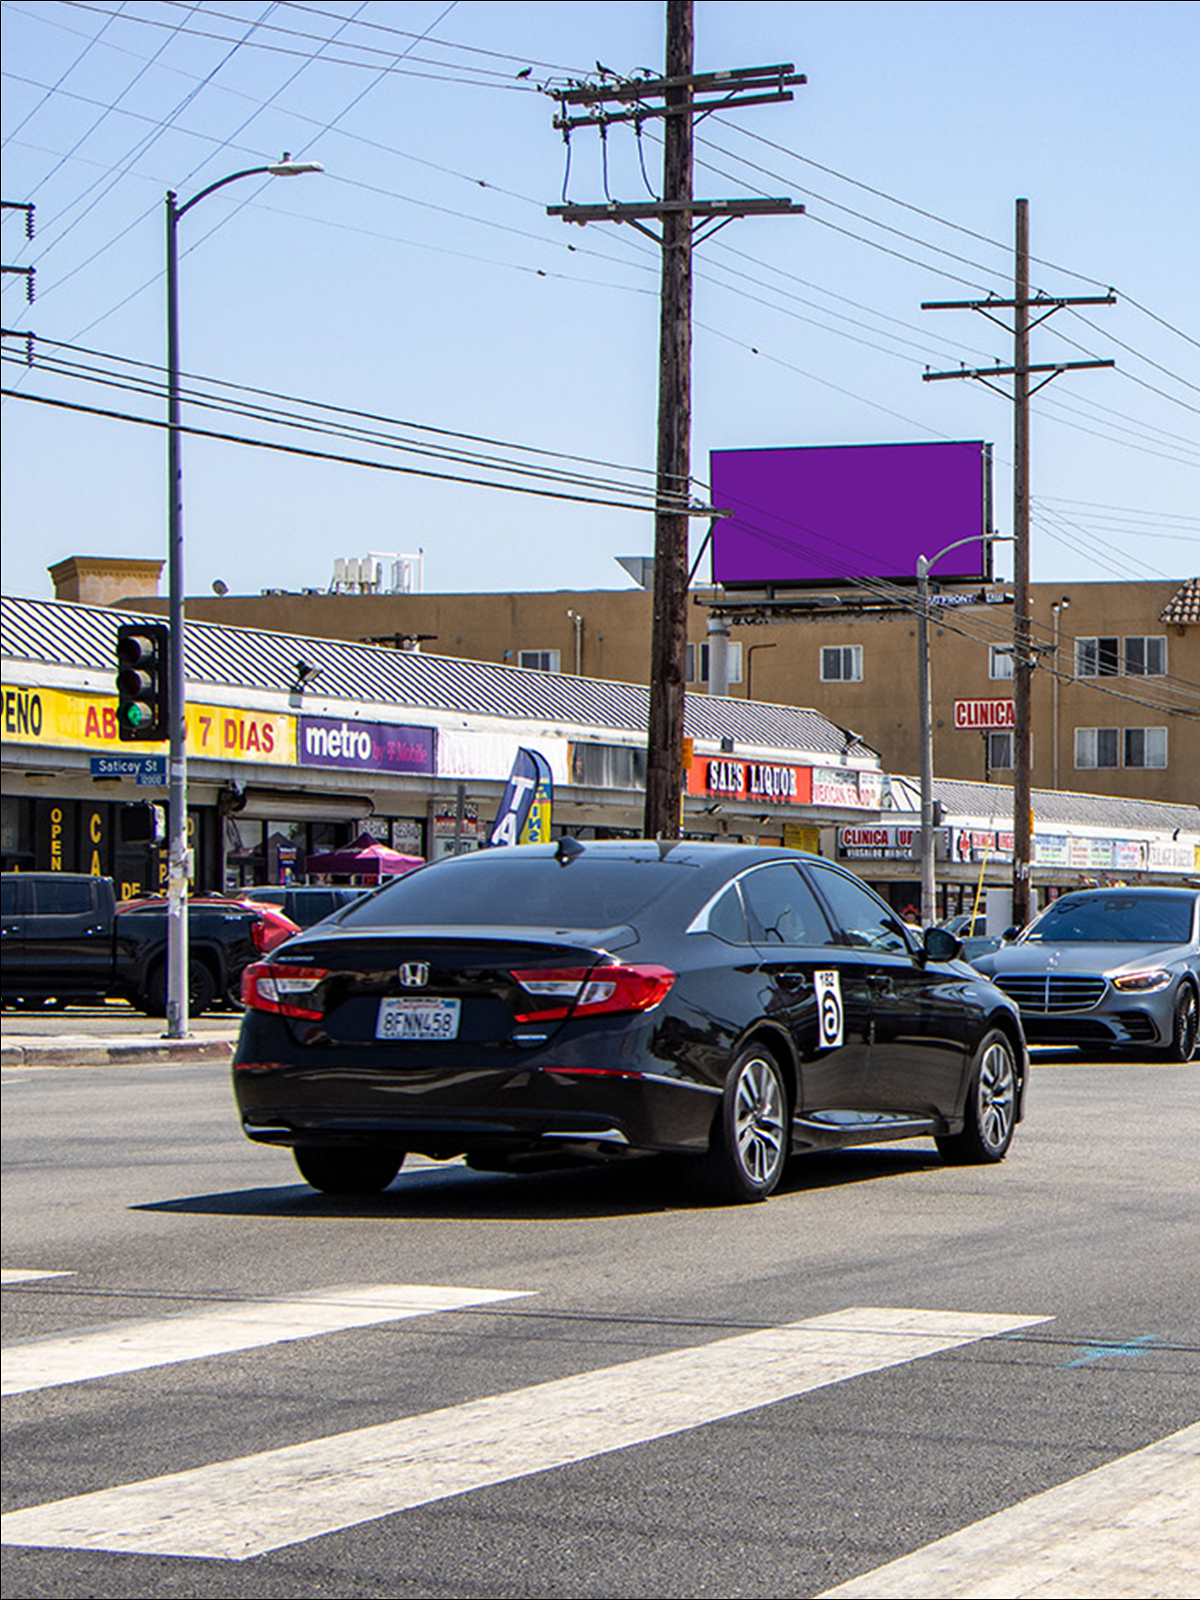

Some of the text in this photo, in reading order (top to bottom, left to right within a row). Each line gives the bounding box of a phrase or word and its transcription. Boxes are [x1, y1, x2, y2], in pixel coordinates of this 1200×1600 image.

[956, 702, 1015, 726] CLINICA
[224, 719, 274, 753] DIAS
[306, 723, 371, 760] metro
[99, 760, 157, 775] Saticoy St
[709, 760, 744, 793] SAL'S
[749, 765, 797, 797] LIQUOR
[50, 808, 62, 871] OPEN
[844, 829, 889, 846] CLINICA
[383, 1012, 453, 1031] 8FNN458
